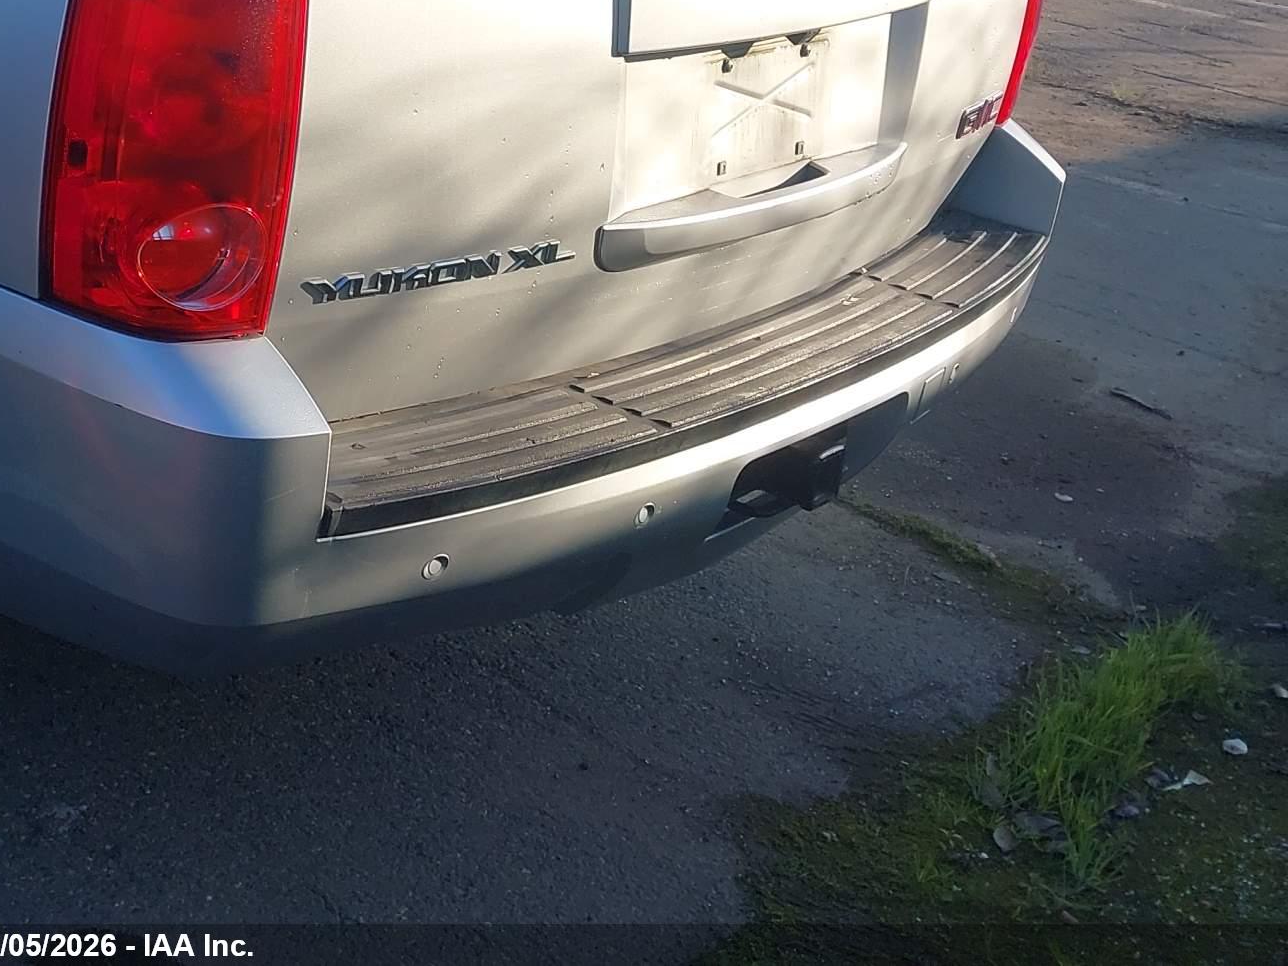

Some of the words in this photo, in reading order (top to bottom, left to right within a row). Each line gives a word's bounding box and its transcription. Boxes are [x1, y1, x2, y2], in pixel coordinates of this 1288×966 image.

[955, 91, 1003, 140] GMC
[300, 250, 502, 305] YUKON
[502, 239, 576, 274] XL
